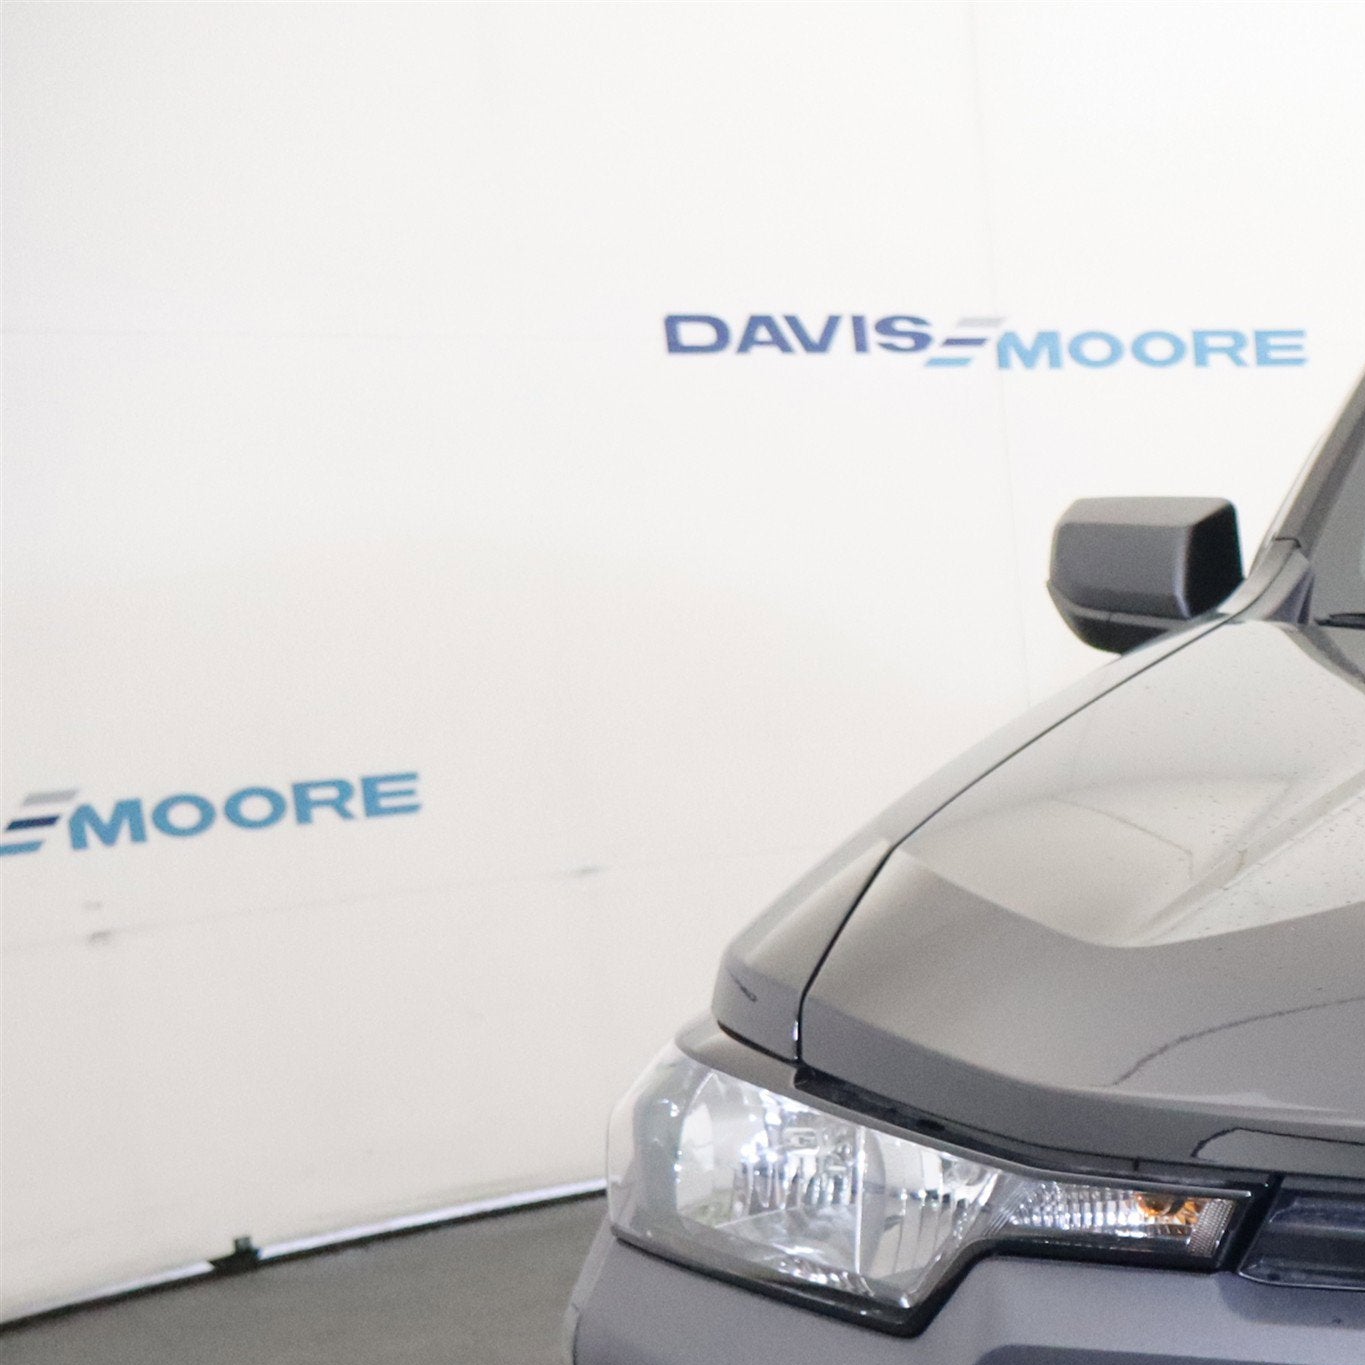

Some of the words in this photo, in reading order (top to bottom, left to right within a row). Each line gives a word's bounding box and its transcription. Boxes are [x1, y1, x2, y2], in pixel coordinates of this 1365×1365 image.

[664, 314, 934, 354] DAVIS
[997, 329, 1308, 369] MOORE
[69, 772, 421, 850] MOORE
